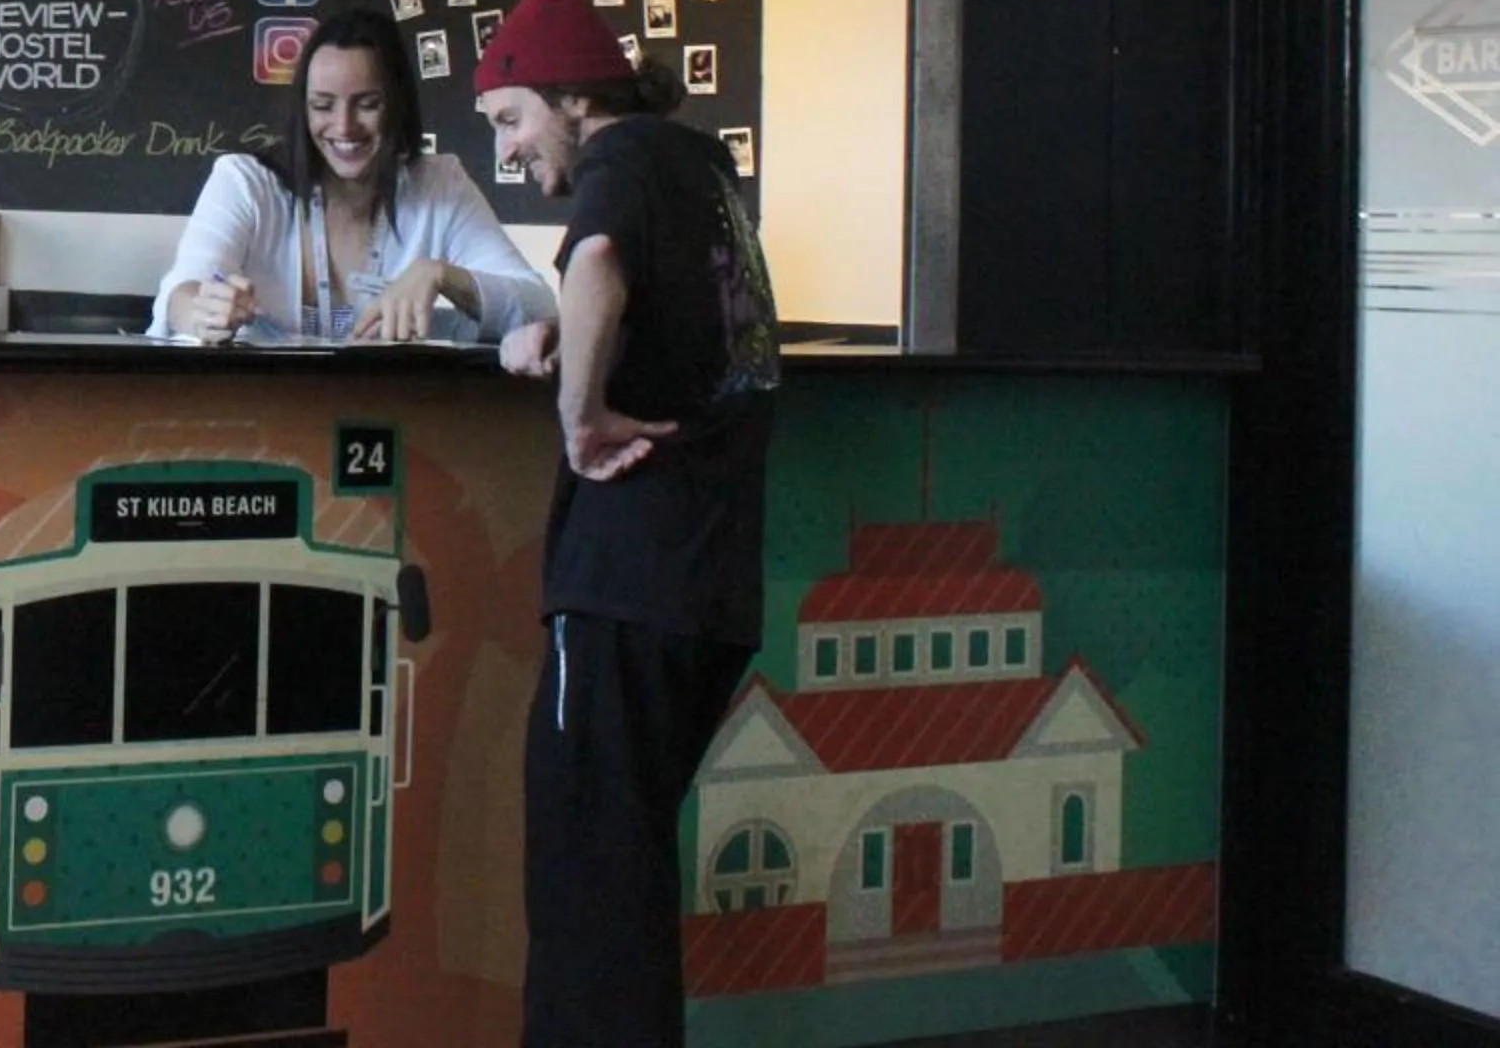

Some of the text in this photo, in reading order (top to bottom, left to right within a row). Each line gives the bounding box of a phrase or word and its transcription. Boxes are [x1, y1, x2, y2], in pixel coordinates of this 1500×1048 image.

[1436, 37, 1500, 75] BAR
[346, 441, 387, 474] 24
[116, 495, 277, 518] ST KILDA BEACH
[149, 866, 217, 907] 932
